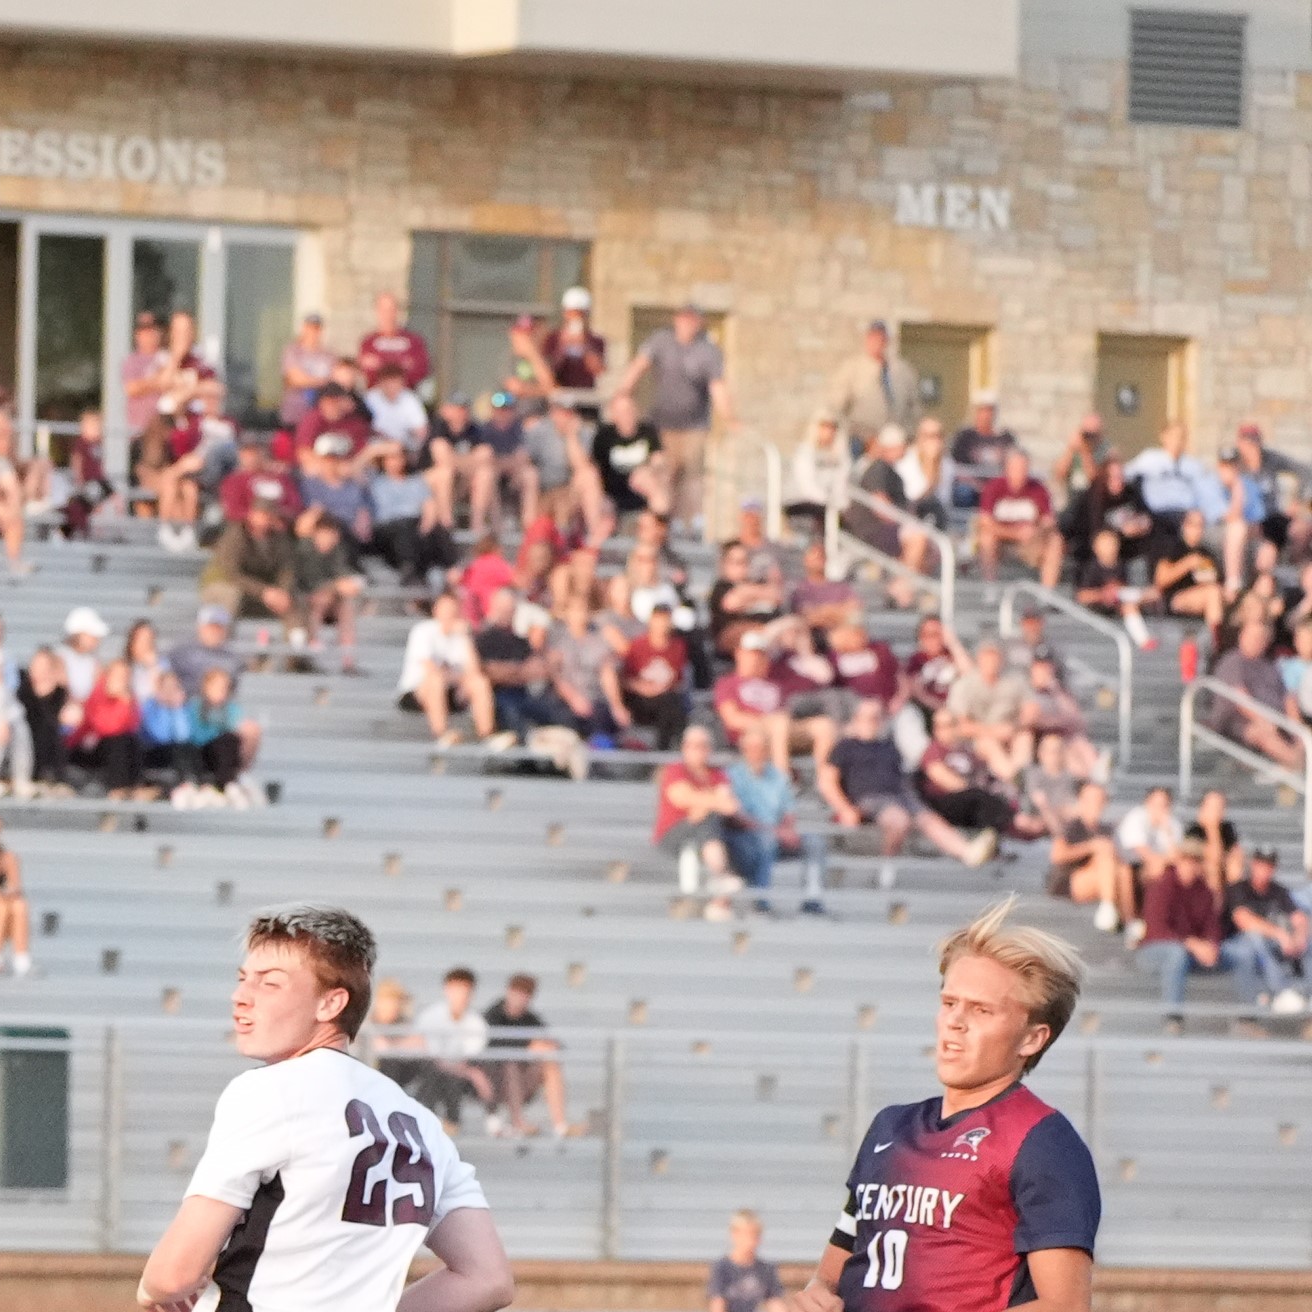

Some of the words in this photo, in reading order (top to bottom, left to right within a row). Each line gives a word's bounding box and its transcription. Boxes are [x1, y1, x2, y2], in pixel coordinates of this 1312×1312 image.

[895, 183, 1011, 231] MEN
[341, 1098, 435, 1227] 29
[856, 1183, 965, 1229] CENTURY
[863, 1229, 908, 1290] 10
